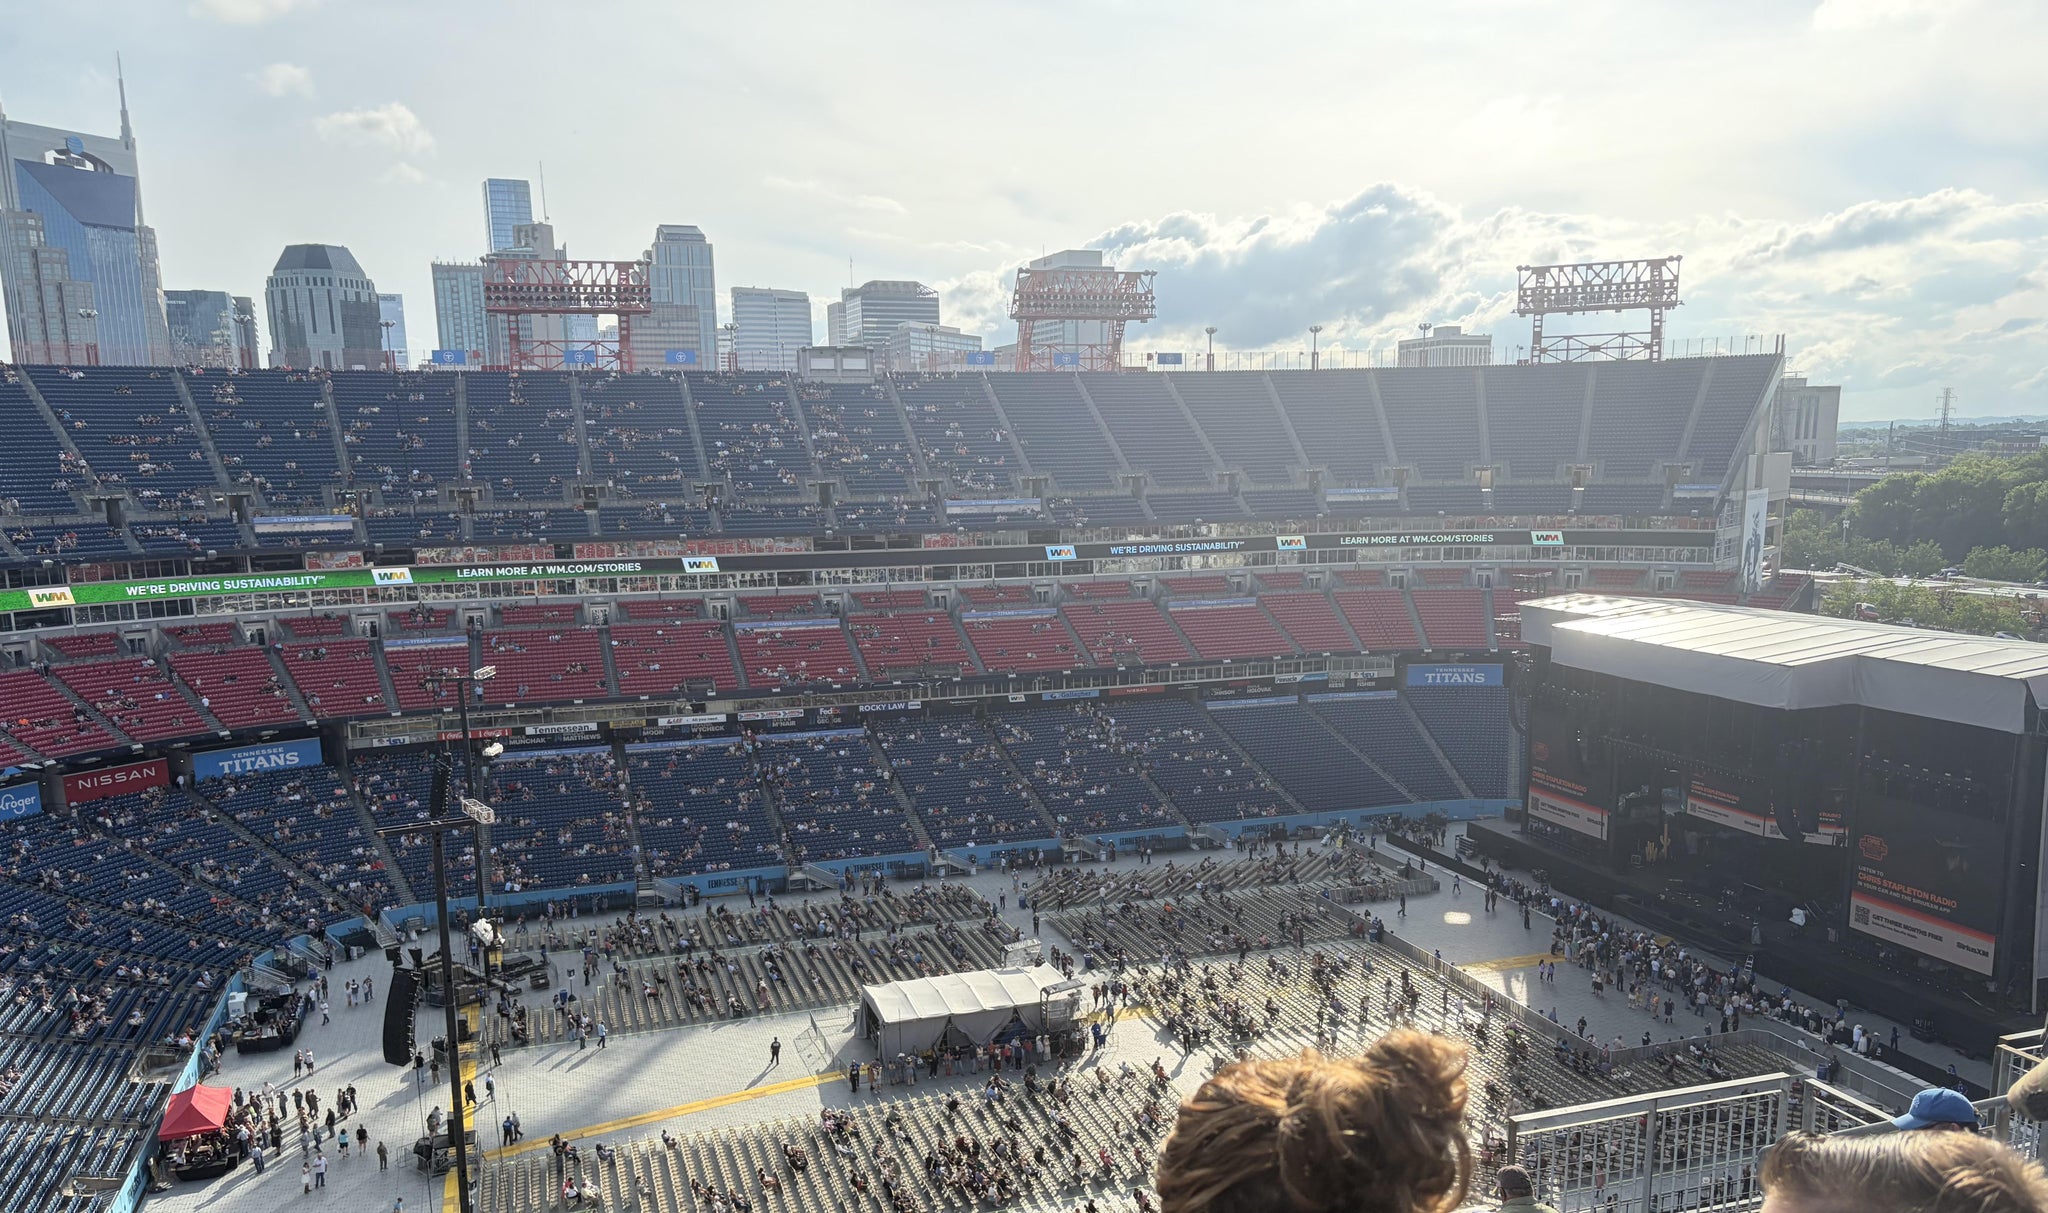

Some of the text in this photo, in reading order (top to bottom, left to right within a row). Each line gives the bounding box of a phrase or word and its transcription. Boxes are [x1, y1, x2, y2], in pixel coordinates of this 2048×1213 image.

[1340, 534, 1494, 545] LEARN MORE AT WM.COM/STORIES
[1110, 545, 1137, 555] WE'RE
[1139, 543, 1173, 553] DRIVING
[457, 562, 641, 578] LEARN MORE AT WM.COM/STORIES
[688, 560, 714, 569] WM
[378, 571, 407, 581] WM
[126, 585, 166, 596] WE'RE
[169, 581, 220, 592] DRIVING
[35, 591, 68, 602] WM
[1425, 673, 1485, 683] TITANS
[859, 704, 886, 712] ROCKY
[888, 702, 905, 710] LAW
[509, 737, 546, 746] MUNCHAK
[563, 734, 601, 742] MATTHEWS
[232, 746, 284, 758] TENNESSEE
[219, 752, 300, 773] TITANS
[78, 767, 156, 790] NISSAN
[1858, 872, 1957, 908] CHRIS STAPLETON RADIO
[1903, 923, 1927, 936] MONTHS
[1928, 932, 1944, 942] FREE
